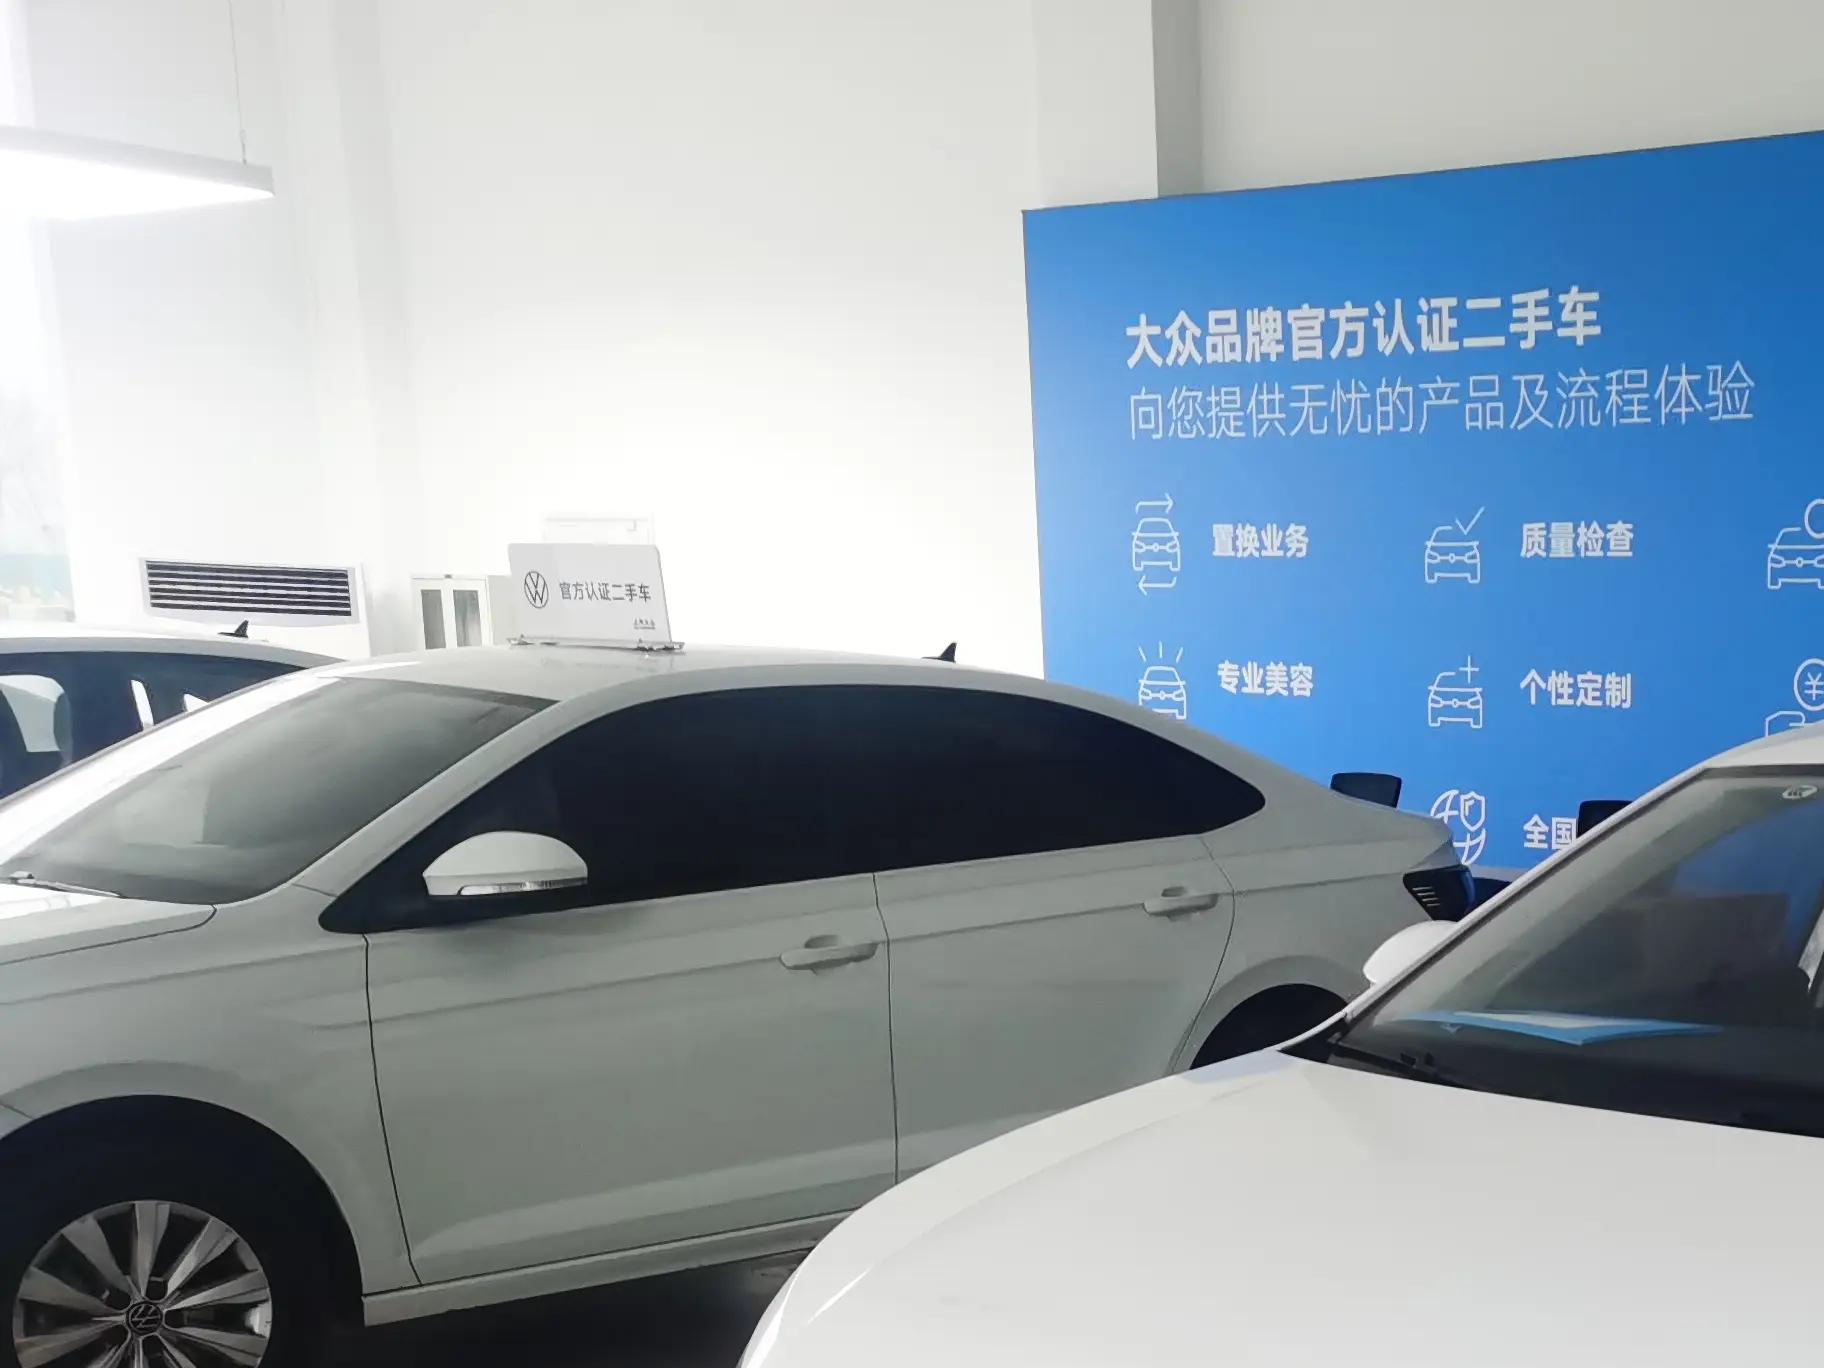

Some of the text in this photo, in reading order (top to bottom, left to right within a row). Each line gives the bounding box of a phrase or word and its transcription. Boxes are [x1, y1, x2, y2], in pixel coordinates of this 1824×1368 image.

[1126, 285, 1601, 369] 大众品牌官方认证二手车
[1130, 360, 1755, 440] 向您提供无忧的产品及流程体验
[1212, 522, 1309, 558] 置换业务
[1520, 520, 1634, 559] 质量检查
[559, 581, 652, 603] 官方认证二手车
[1217, 660, 1313, 697] 专业美容
[1520, 668, 1632, 709] 个性定制
